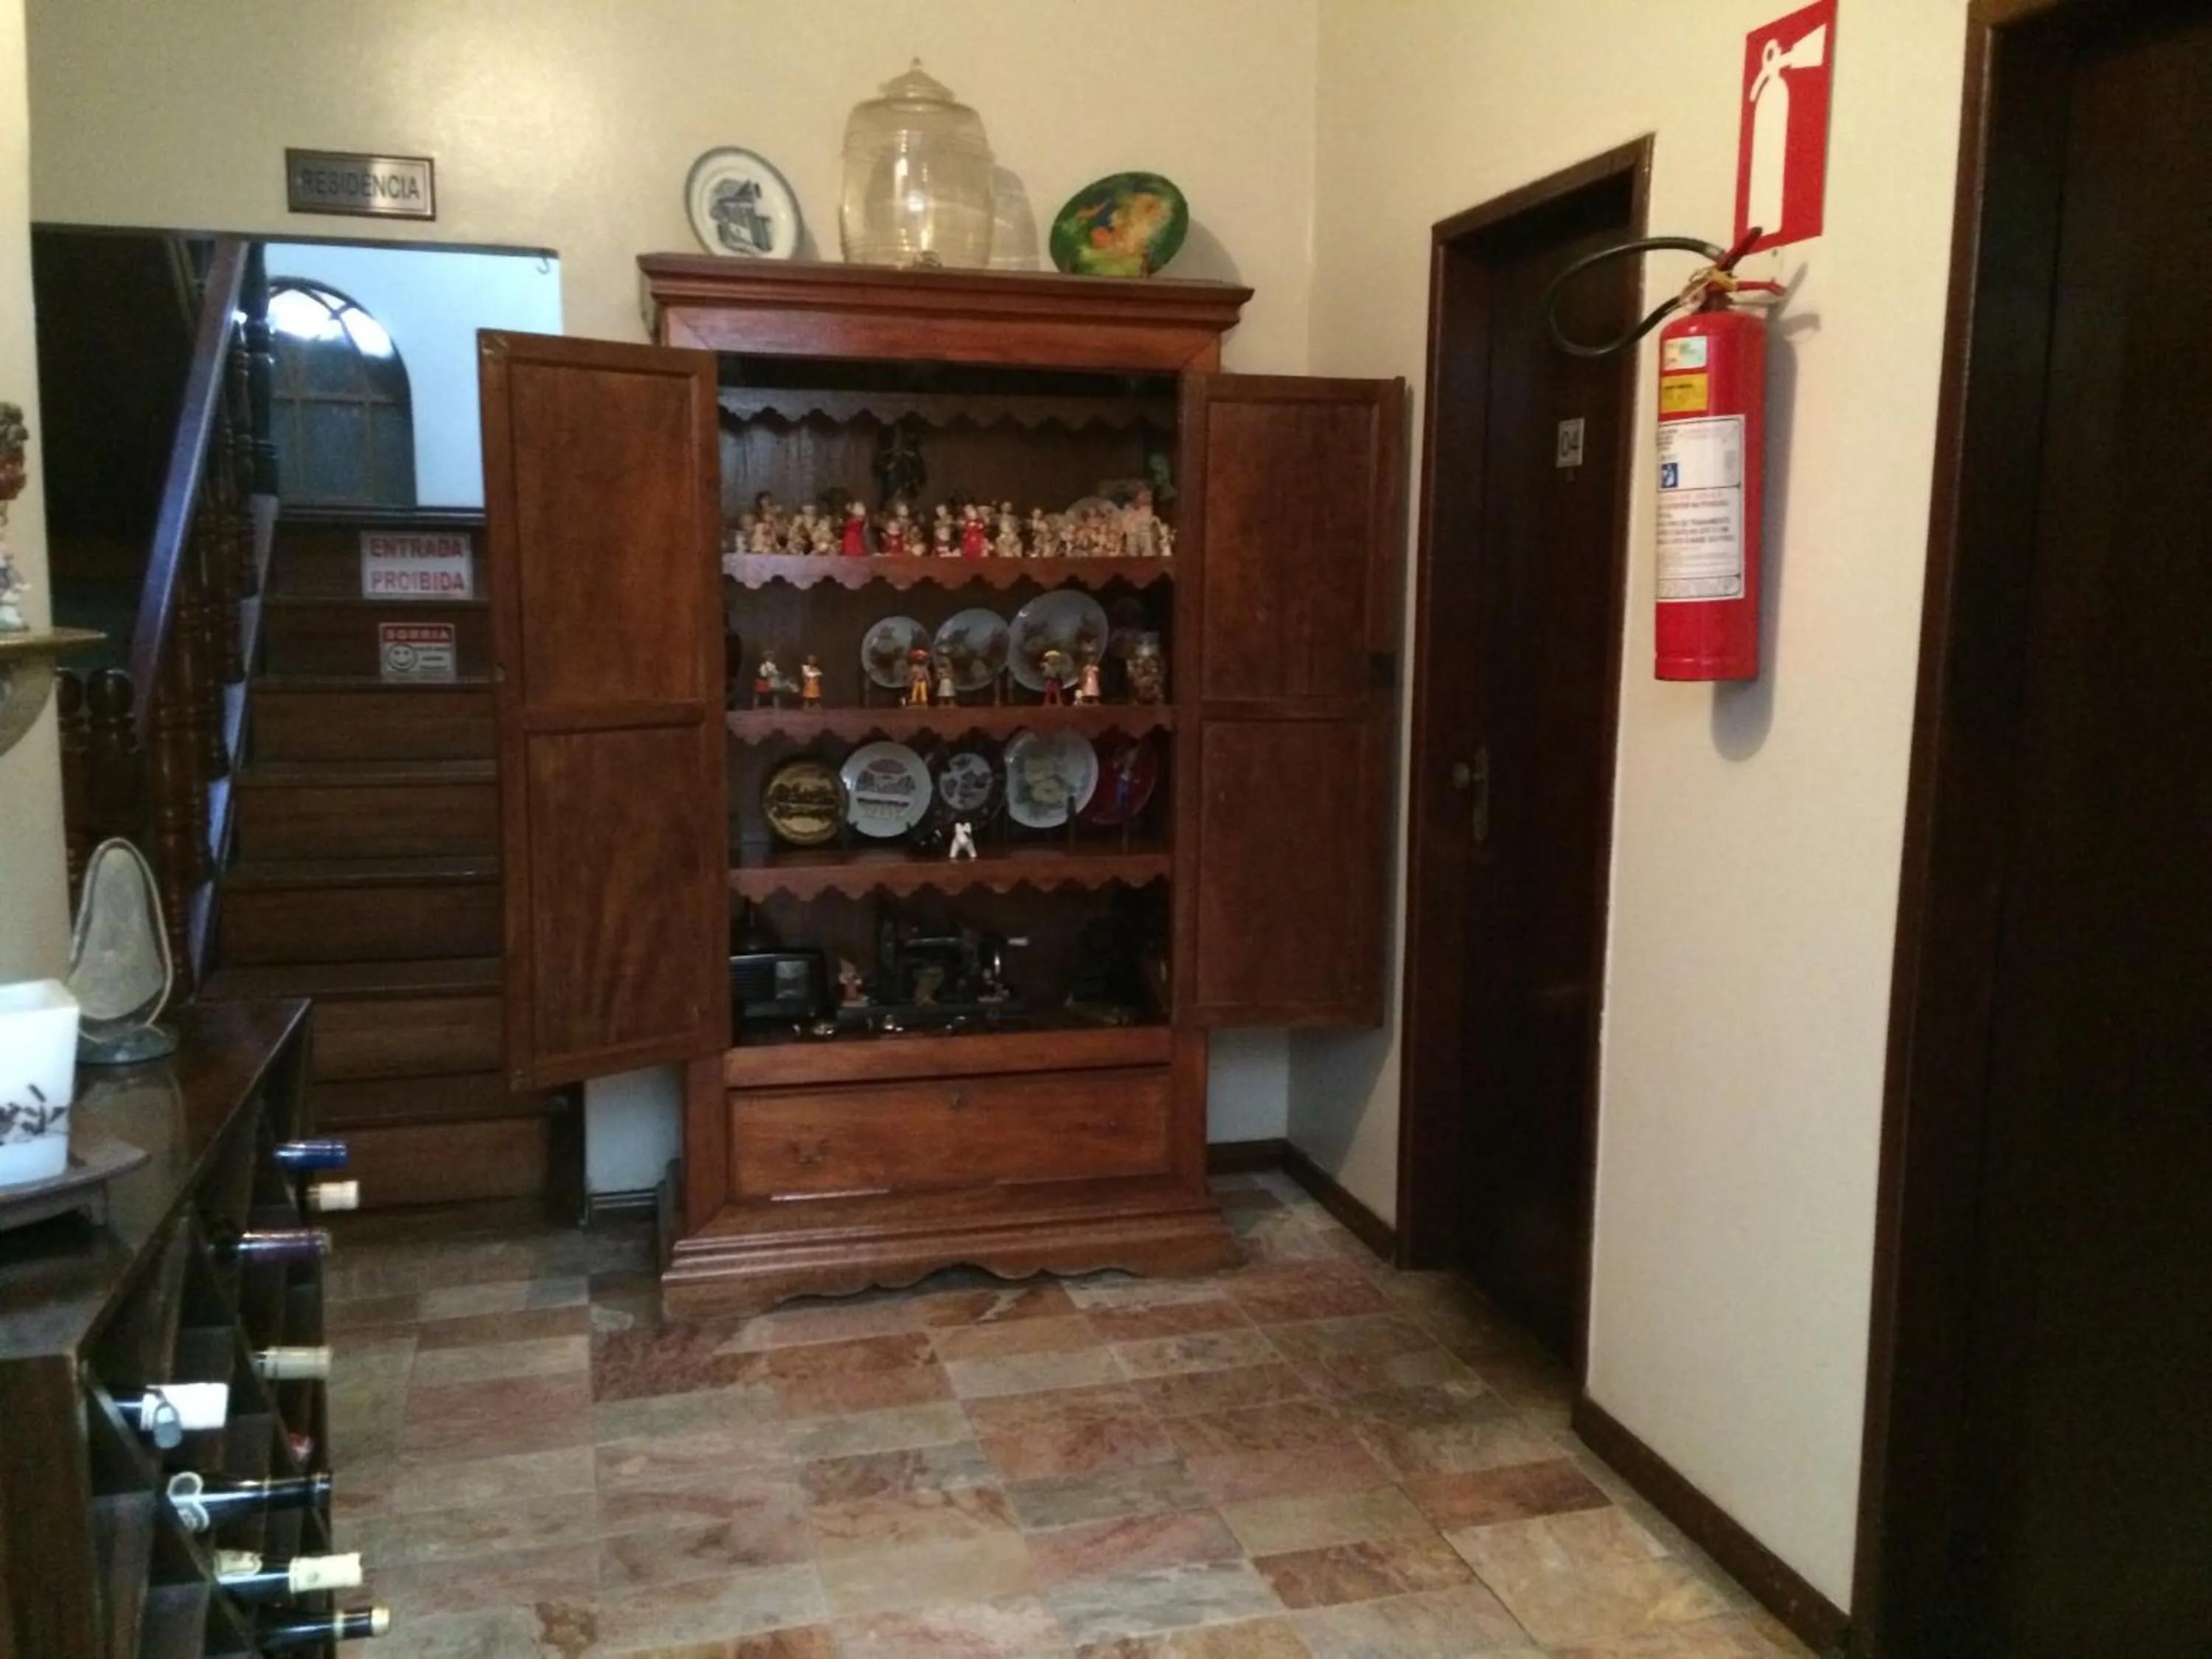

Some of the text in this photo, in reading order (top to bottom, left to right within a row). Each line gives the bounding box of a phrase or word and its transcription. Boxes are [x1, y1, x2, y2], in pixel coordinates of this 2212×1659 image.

[1561, 430, 1579, 458] 04
[370, 537, 463, 558] ENTRADA
[371, 570, 465, 591] PROIBIDA
